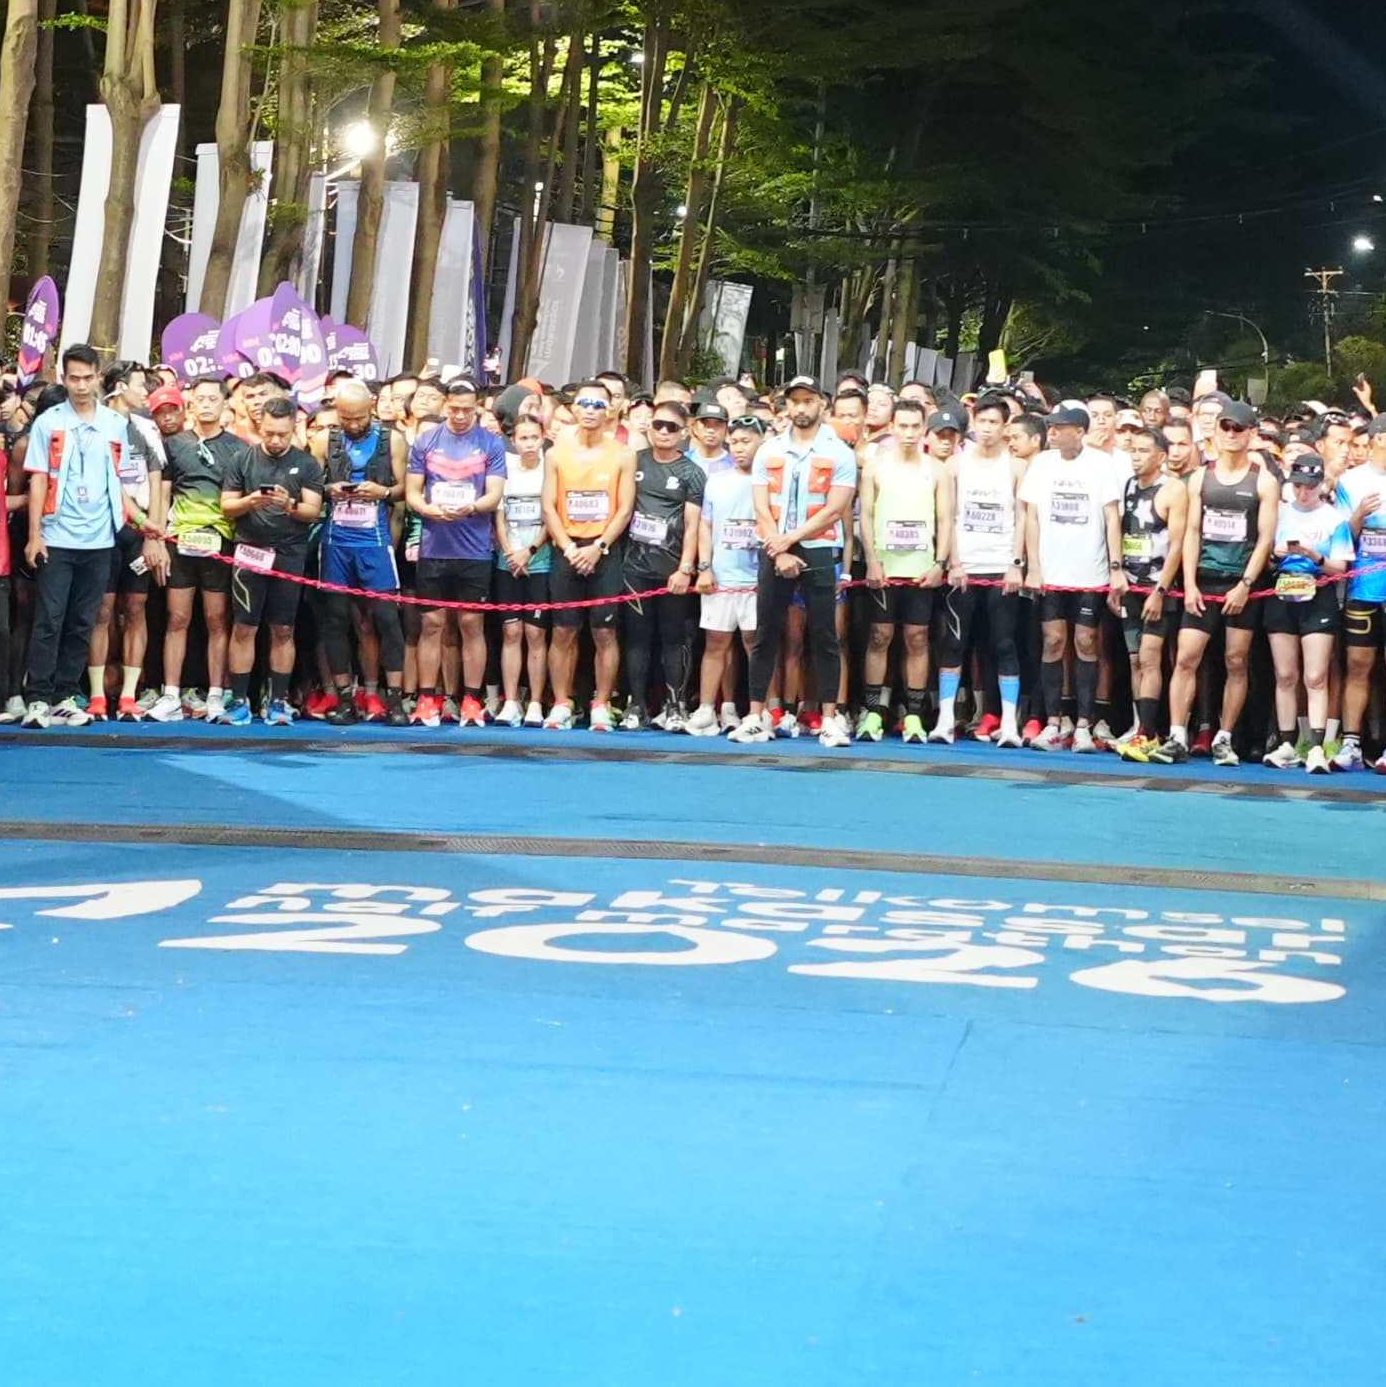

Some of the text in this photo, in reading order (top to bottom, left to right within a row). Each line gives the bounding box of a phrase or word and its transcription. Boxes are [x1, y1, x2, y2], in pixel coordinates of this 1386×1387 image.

[225, 894, 1343, 965] half marathon
[257, 882, 1346, 947] makassar
[668, 878, 1345, 932] Telkomsel
[157, 913, 1349, 1005] 2026
